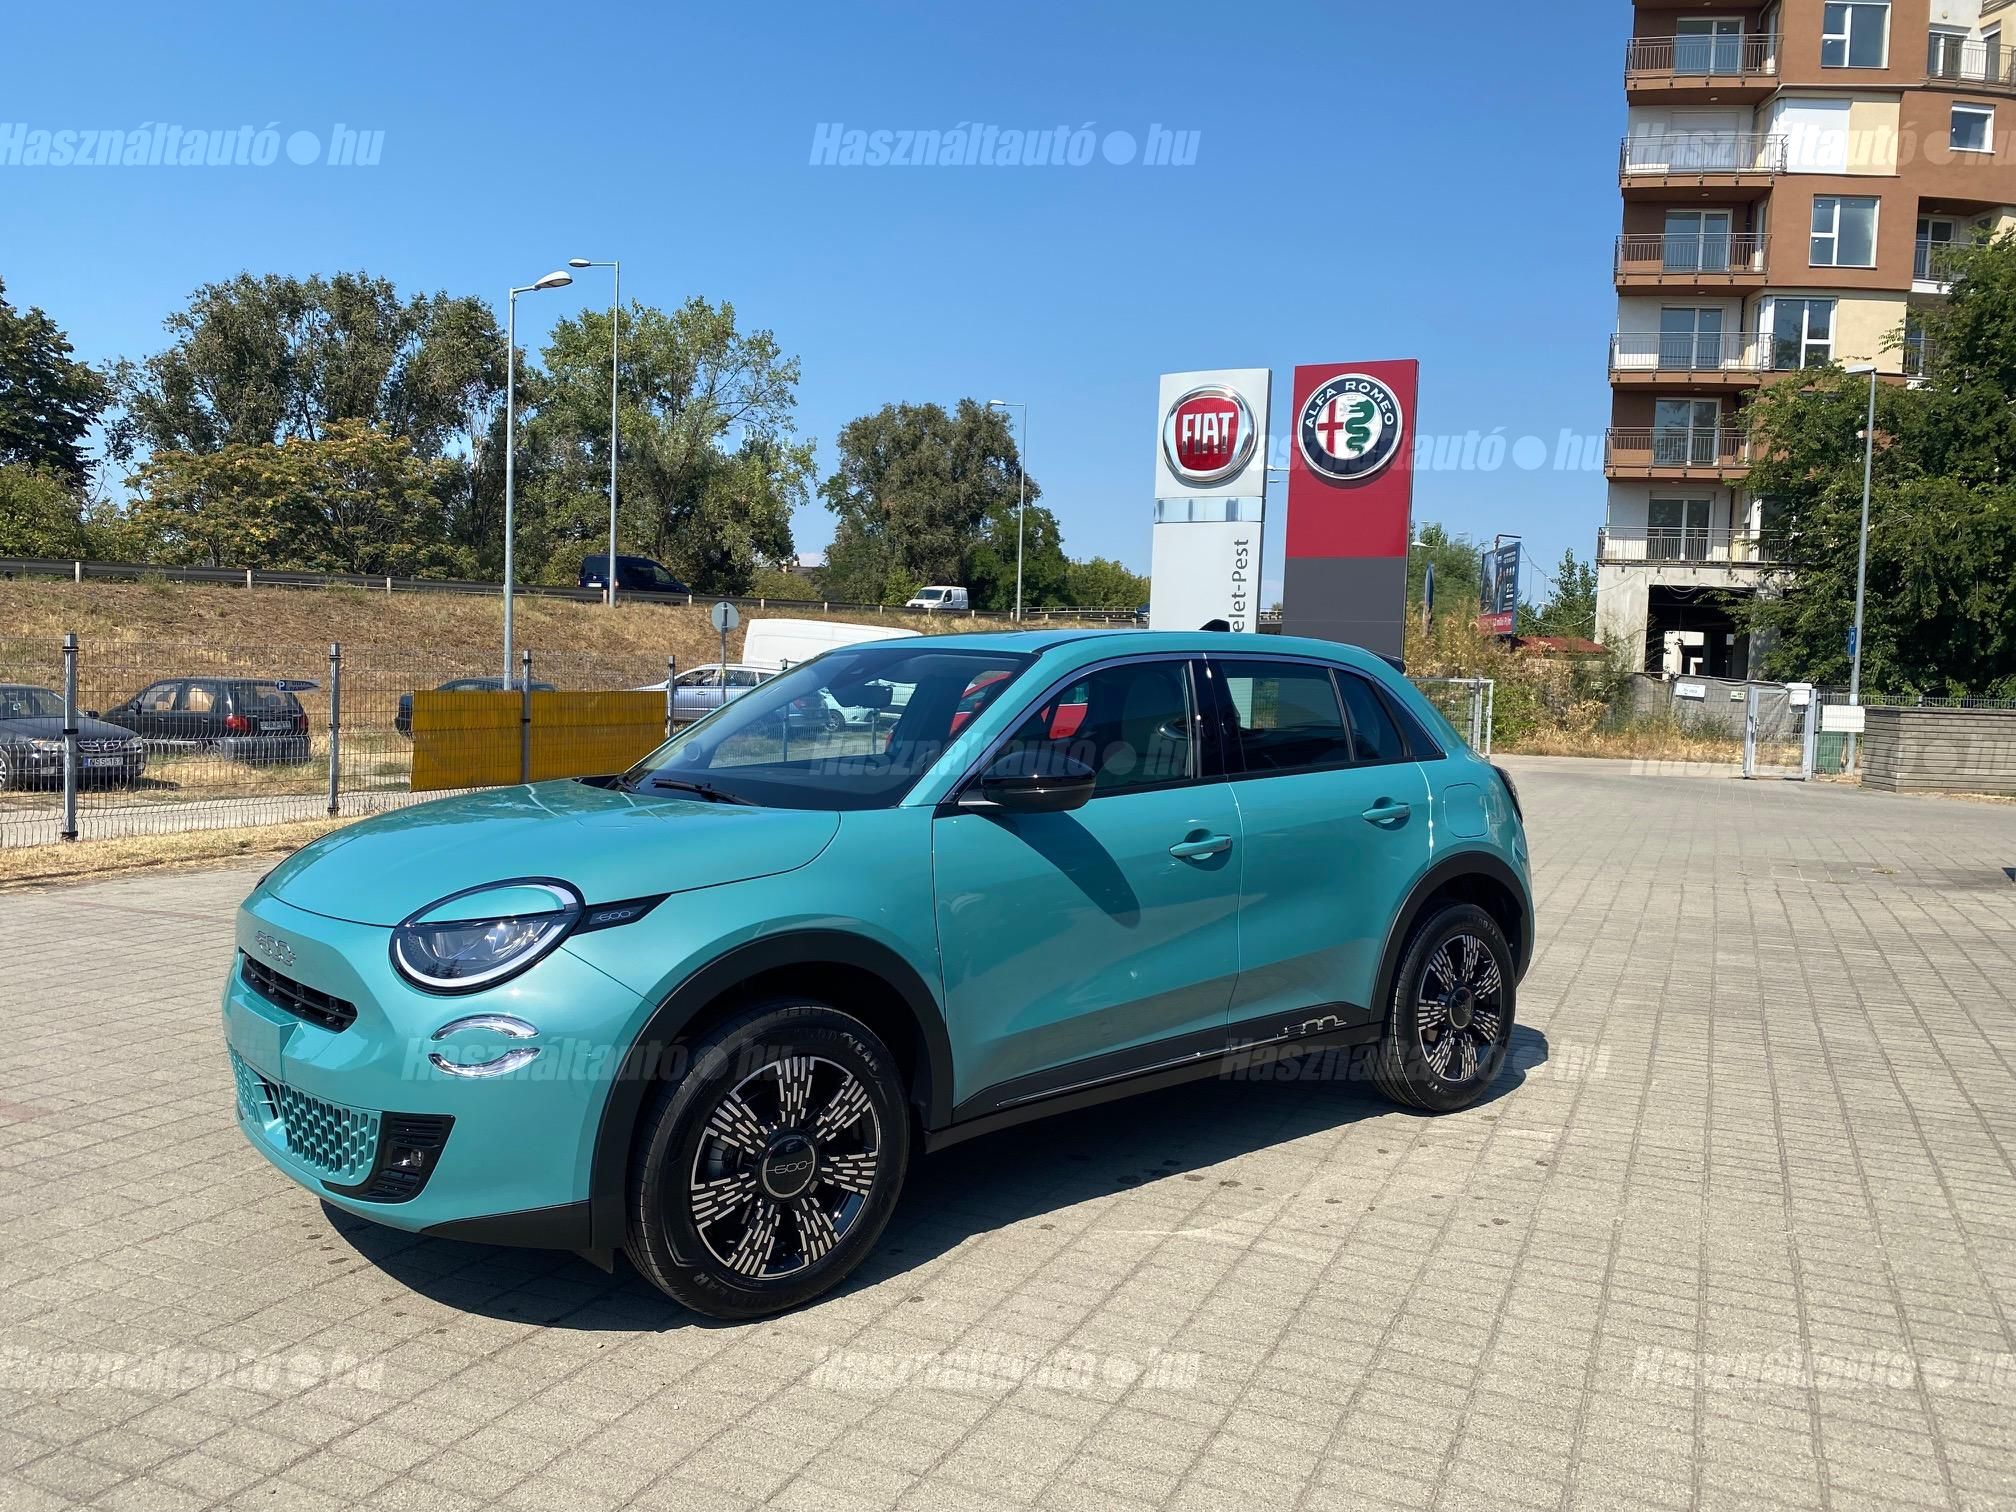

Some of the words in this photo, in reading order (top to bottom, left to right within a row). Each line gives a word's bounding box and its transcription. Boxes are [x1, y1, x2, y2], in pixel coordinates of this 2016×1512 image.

[1305, 388, 1337, 428] ALFA
[1345, 381, 1395, 426] ROMEO
[1182, 412, 1234, 455] FIAT
